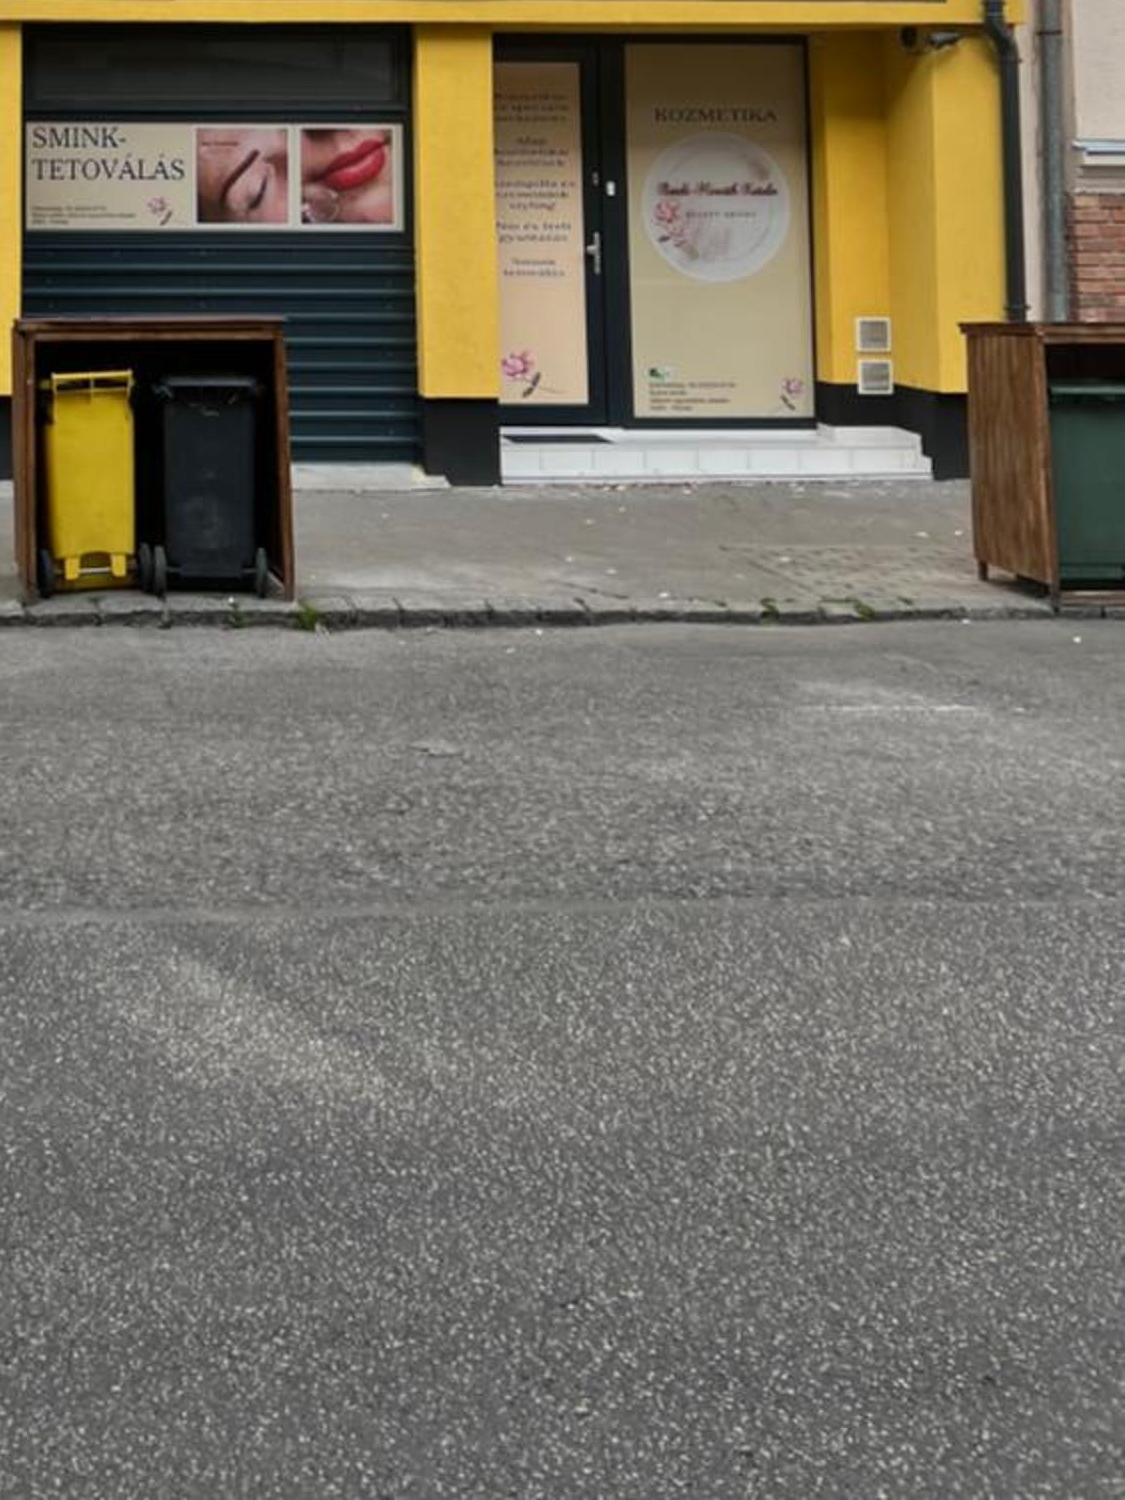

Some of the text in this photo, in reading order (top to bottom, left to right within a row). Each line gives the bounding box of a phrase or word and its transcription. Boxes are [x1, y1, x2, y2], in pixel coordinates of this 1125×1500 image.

[655, 107, 778, 122] KOZMETIKA
[31, 126, 127, 150] SMINK-
[31, 152, 186, 181] TETOVÁLÁS
